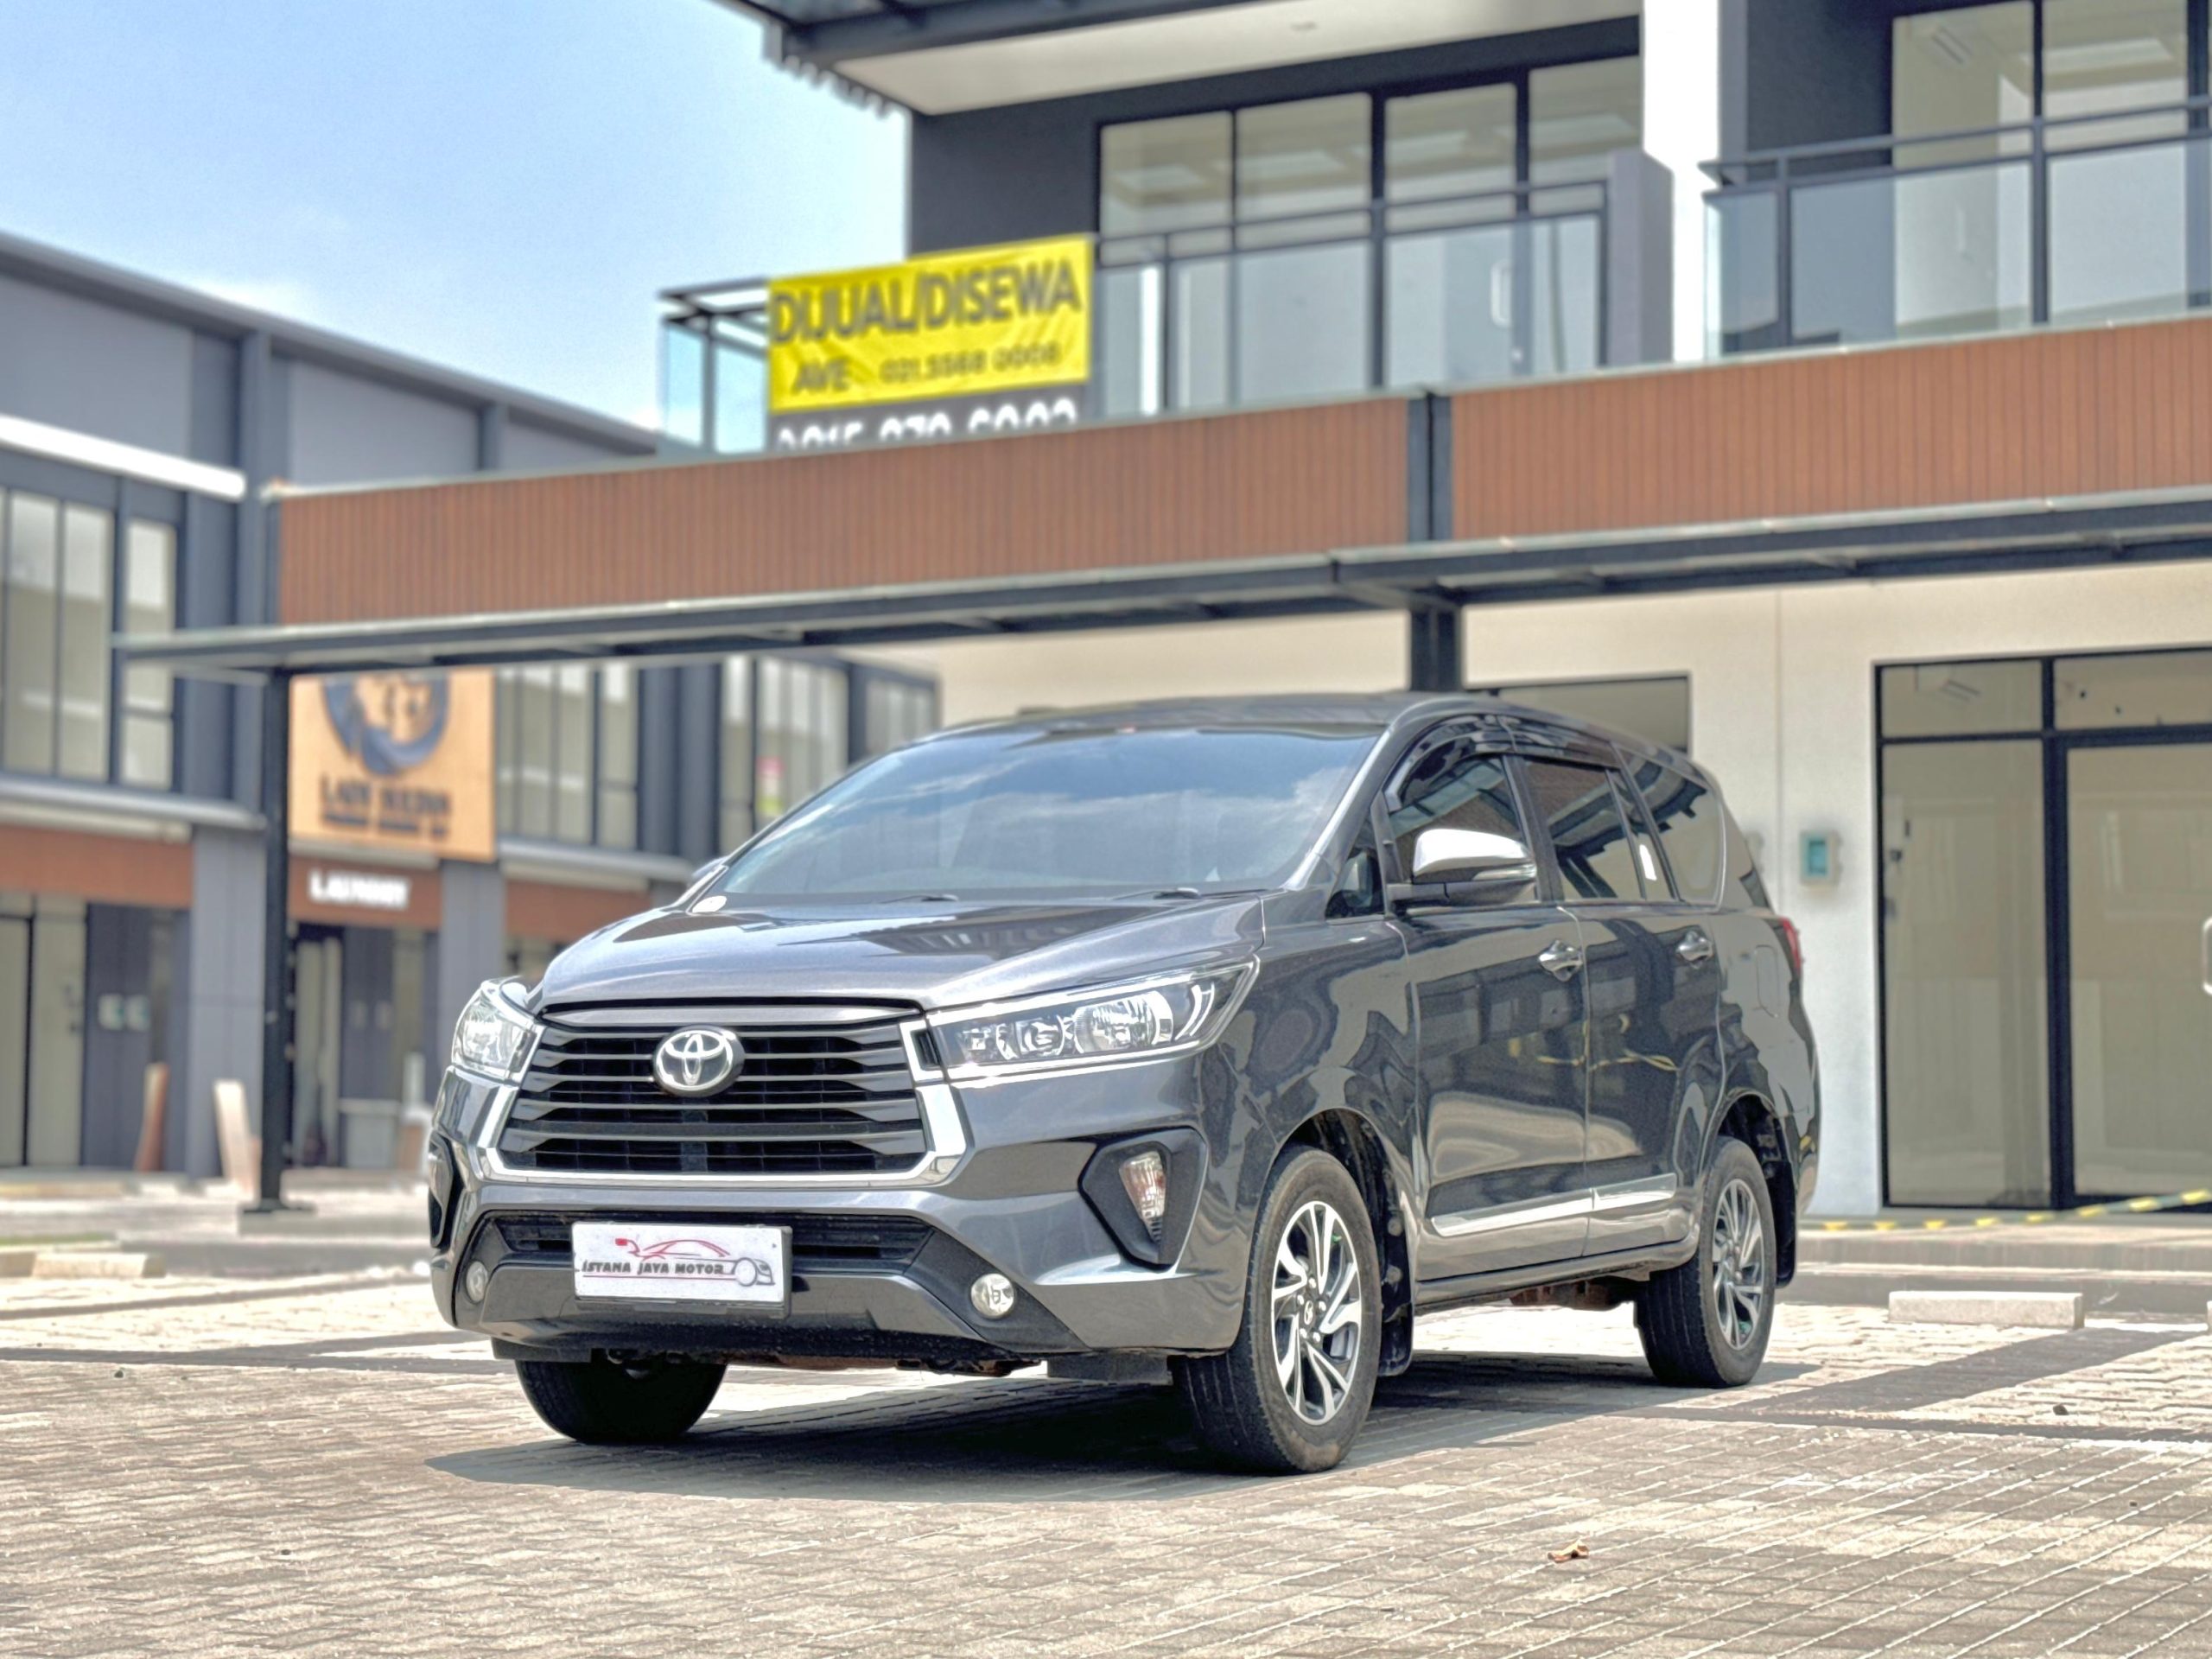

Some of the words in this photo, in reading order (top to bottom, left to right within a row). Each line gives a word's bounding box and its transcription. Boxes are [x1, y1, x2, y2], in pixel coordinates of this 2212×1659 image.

[582, 1260, 631, 1273] ISTANA
[637, 1262, 669, 1275] JAYA
[675, 1263, 724, 1274] MOTOR
